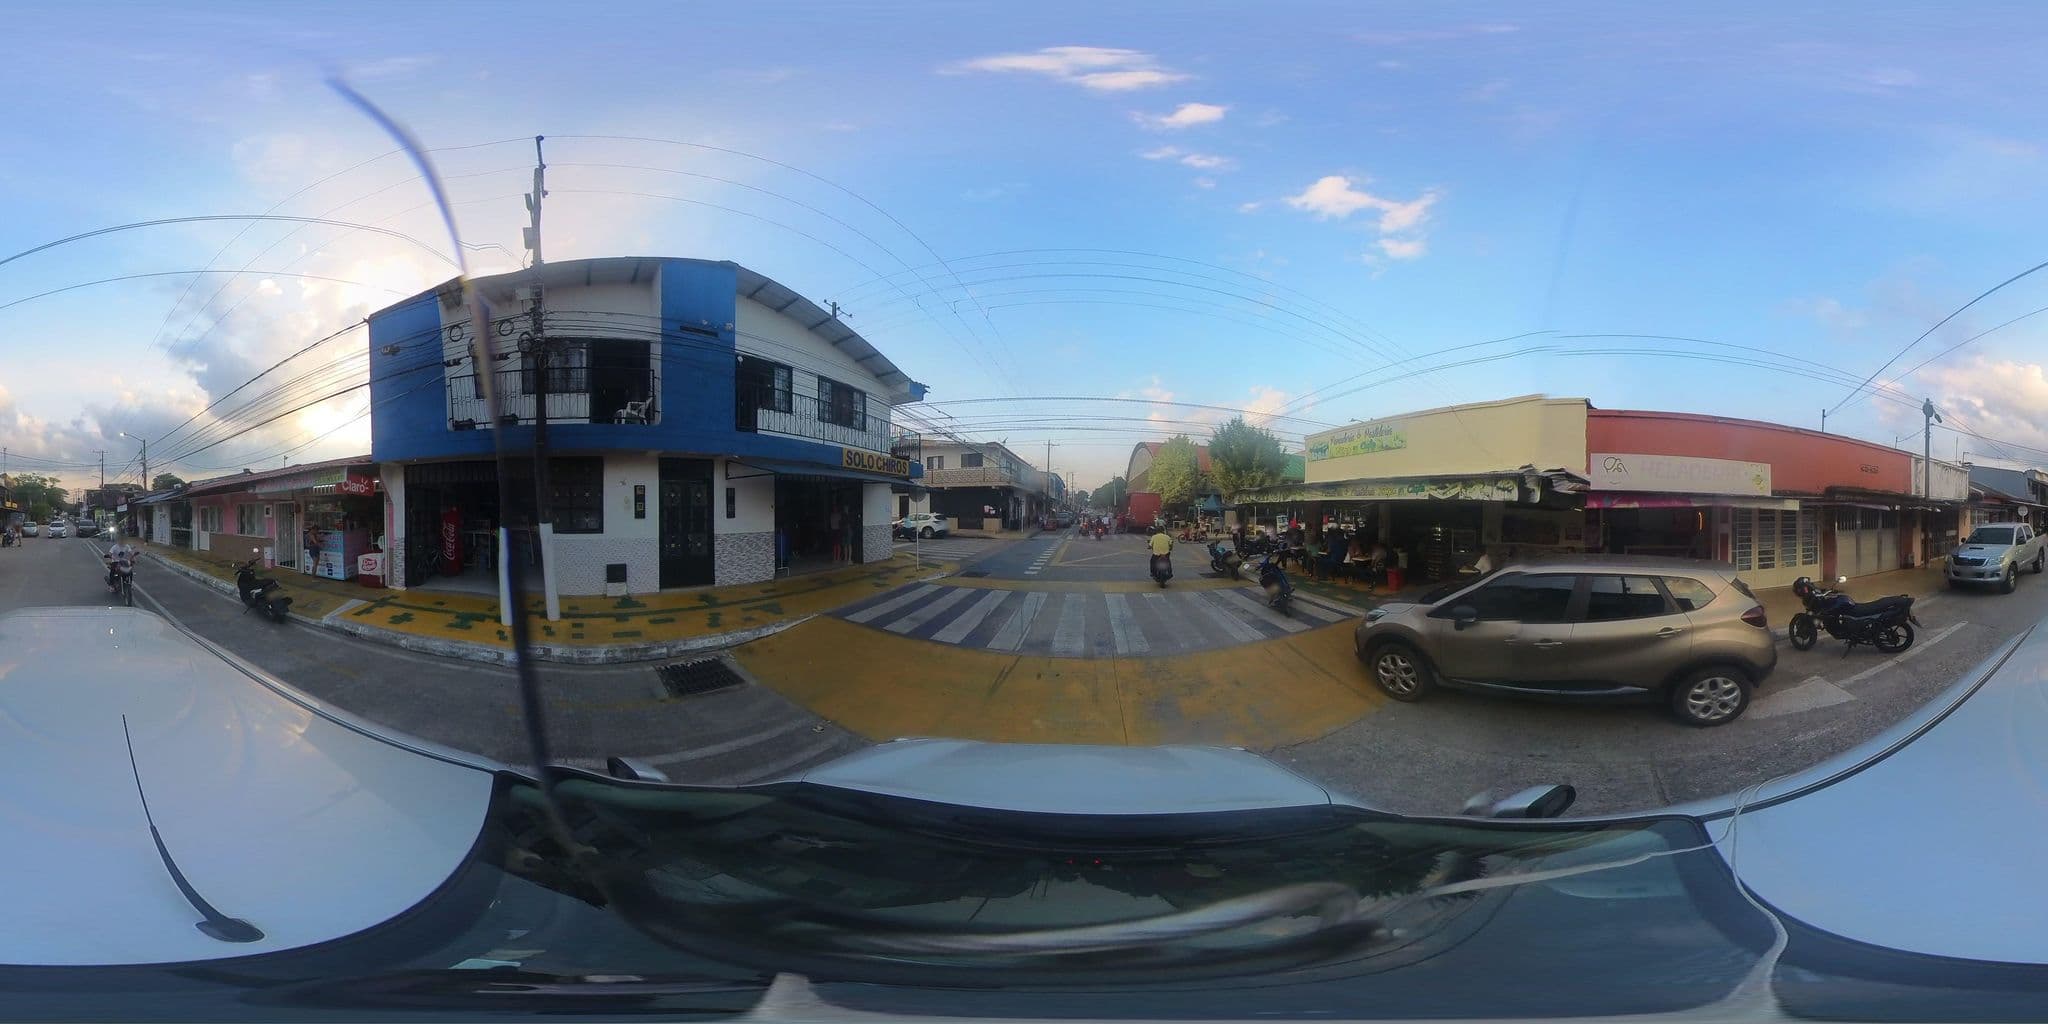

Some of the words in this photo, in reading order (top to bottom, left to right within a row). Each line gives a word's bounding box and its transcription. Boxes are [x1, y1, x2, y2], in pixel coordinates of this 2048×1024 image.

[846, 450, 874, 469] SOLO
[876, 456, 907, 474] CHIROS
[342, 480, 366, 492] Claro
